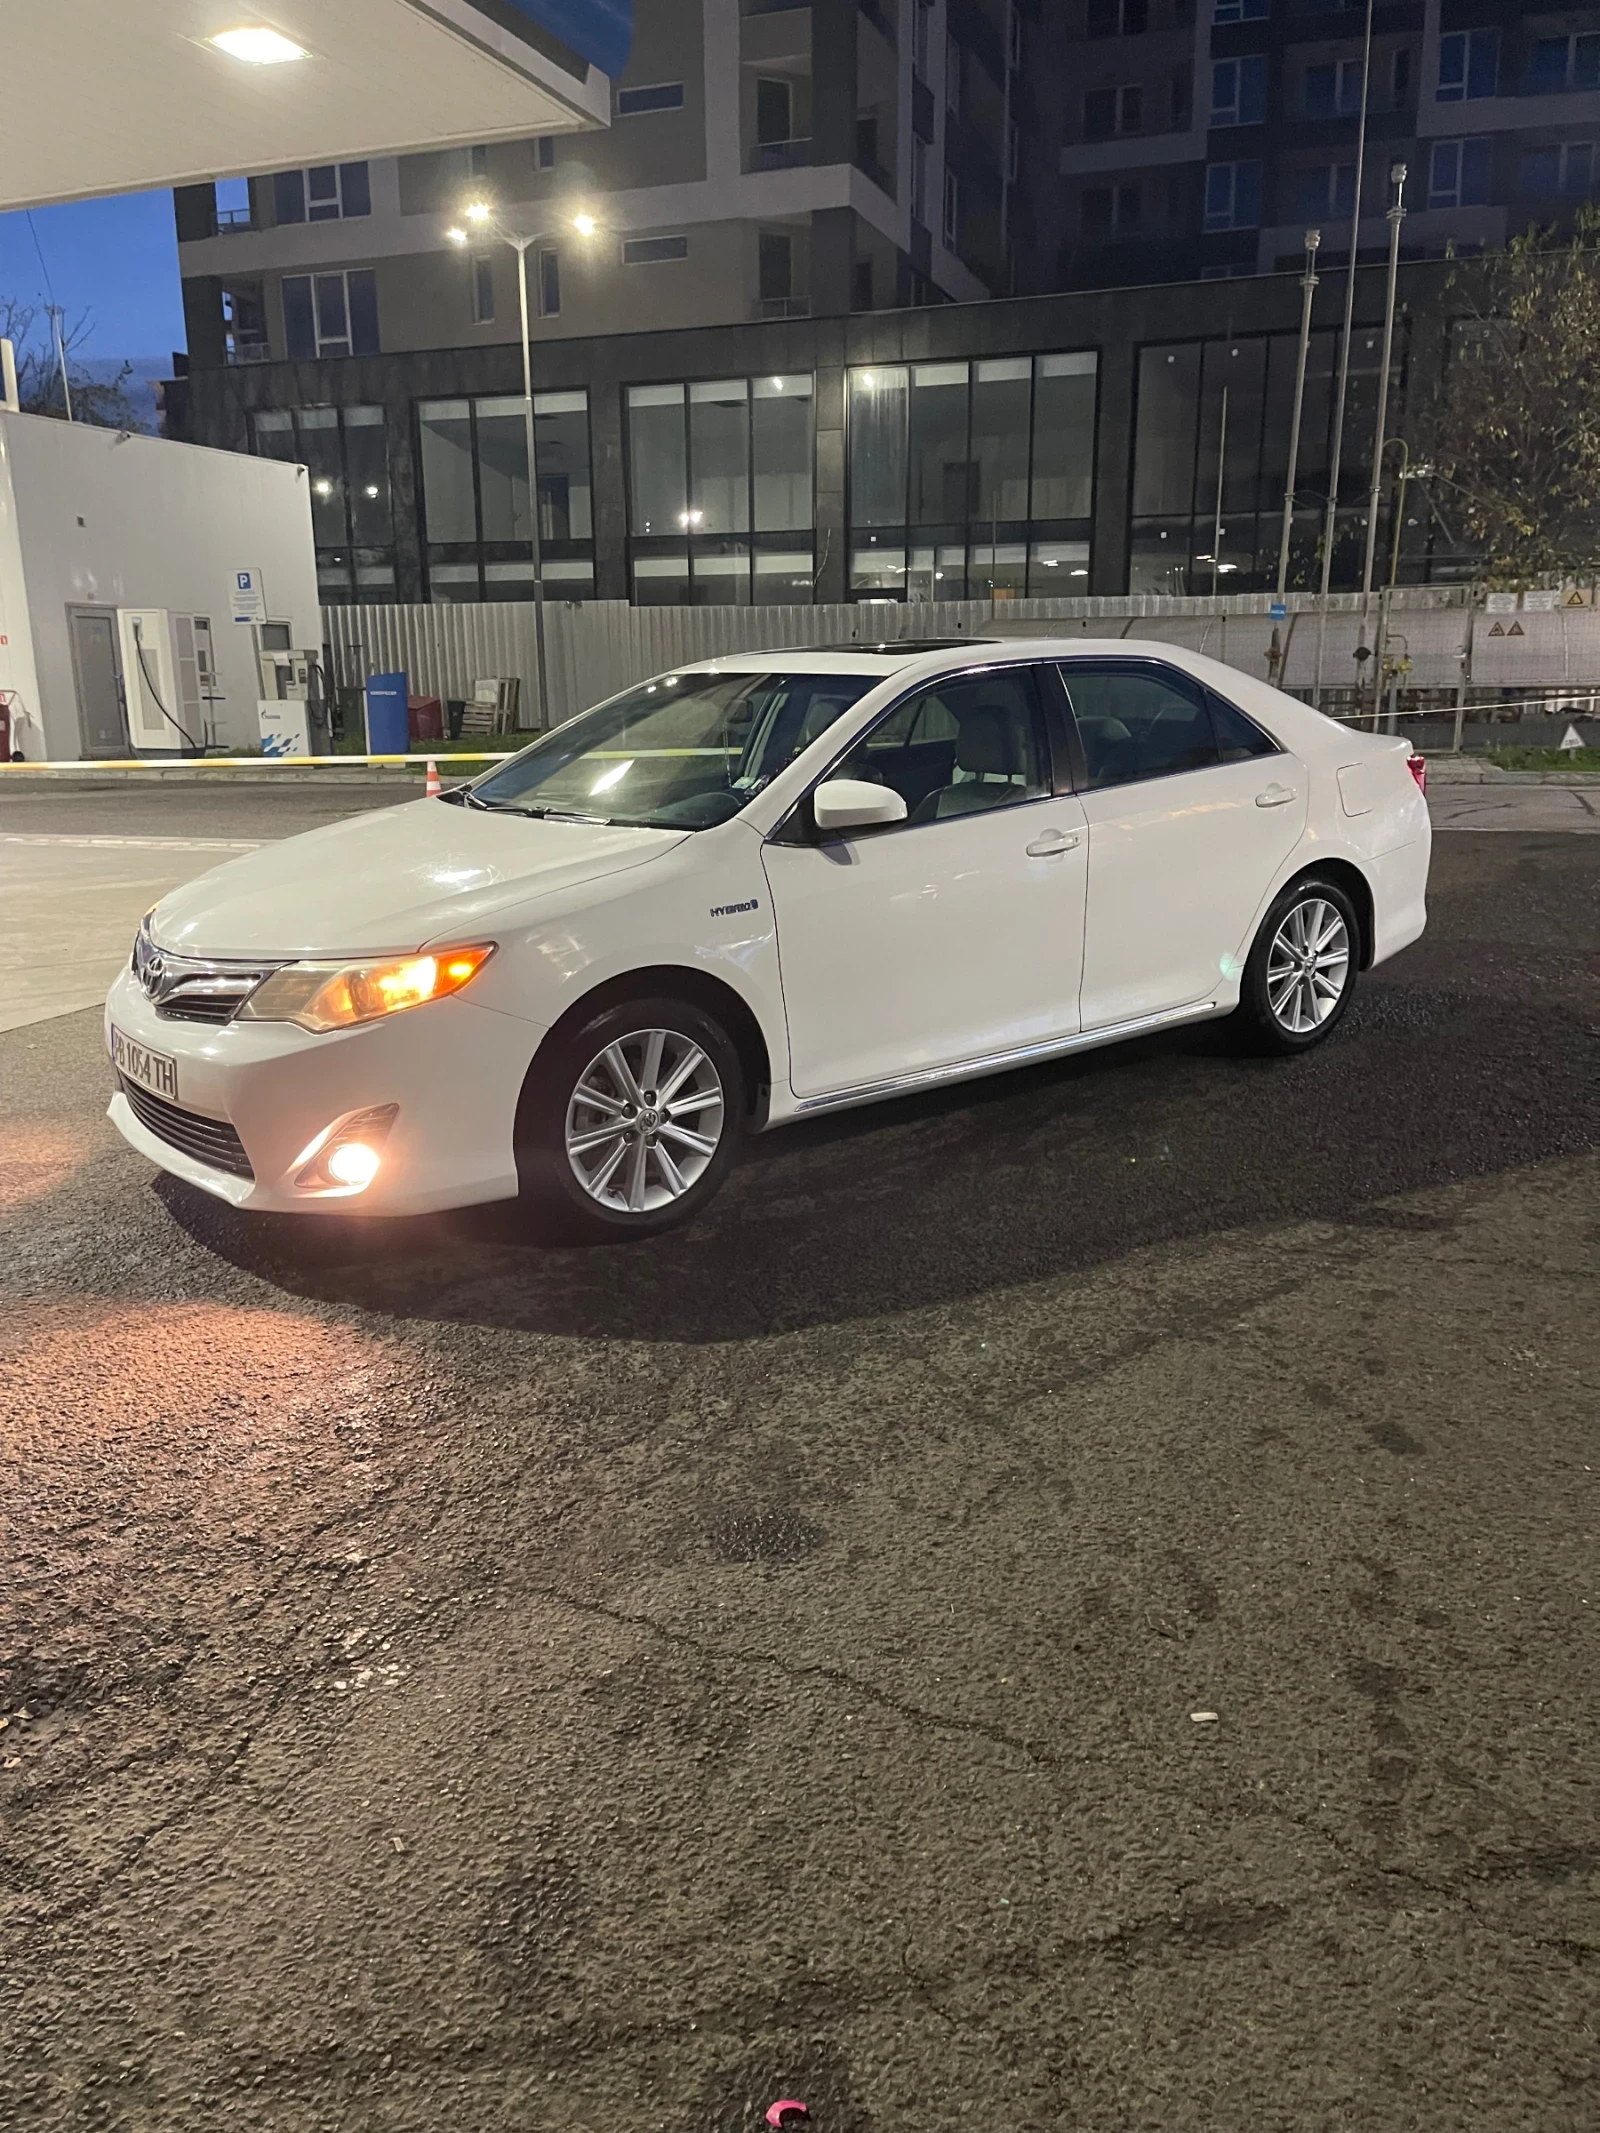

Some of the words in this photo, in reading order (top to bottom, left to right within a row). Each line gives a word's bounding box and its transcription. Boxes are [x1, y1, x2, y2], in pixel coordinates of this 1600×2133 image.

[710, 902, 751, 917] HYBRID
[126, 1042, 151, 1084] 1054
[153, 1056, 173, 1095] TH
